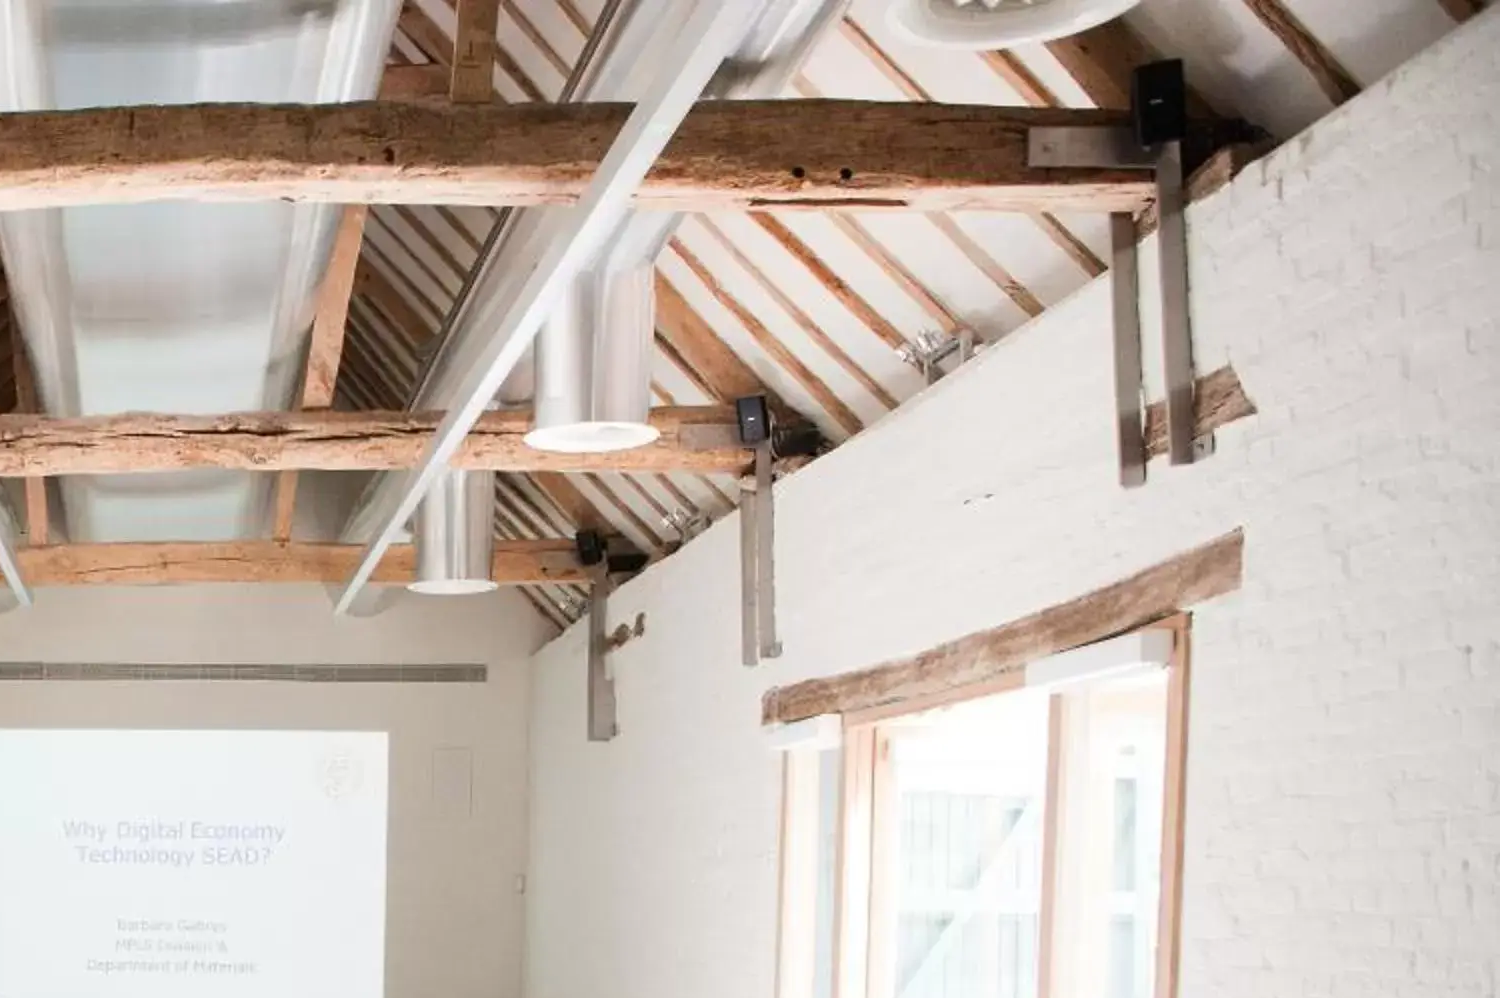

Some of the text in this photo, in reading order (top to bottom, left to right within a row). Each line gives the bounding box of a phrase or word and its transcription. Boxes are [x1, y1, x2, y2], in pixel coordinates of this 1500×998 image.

[62, 819, 285, 843] Why Digital Economy
[73, 846, 272, 868] Technology SEAD?
[86, 958, 170, 975] Department
